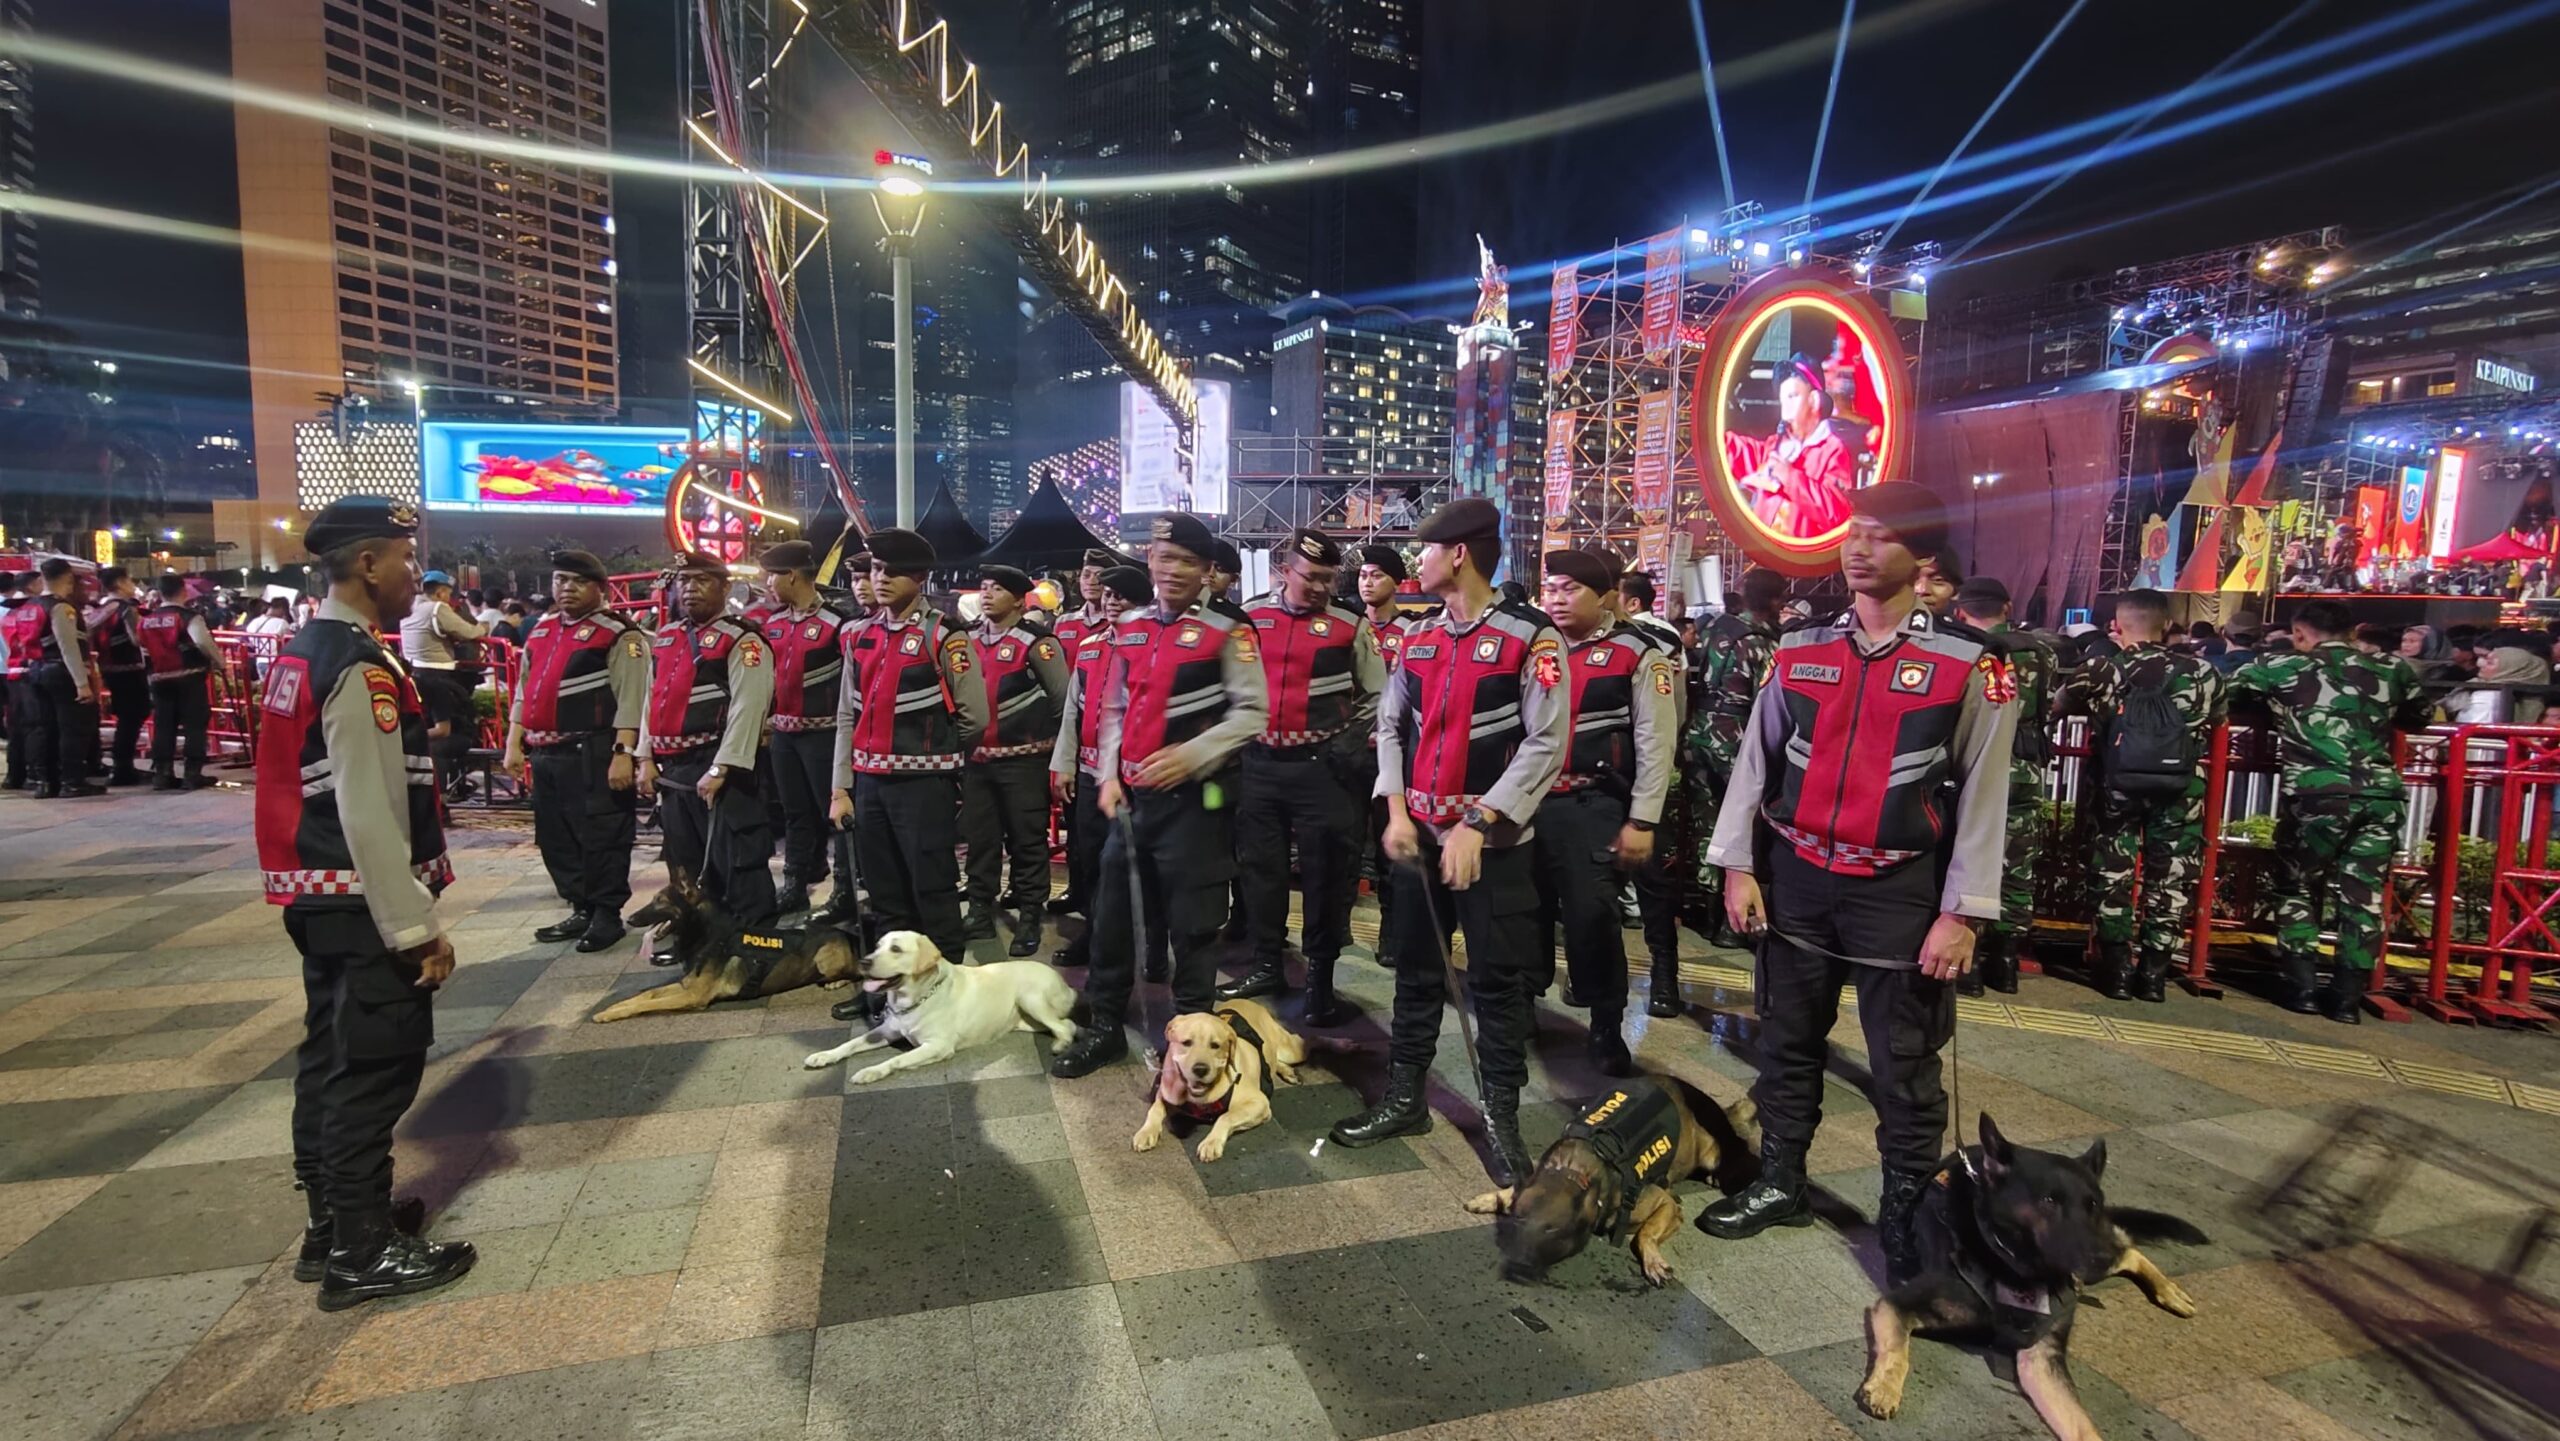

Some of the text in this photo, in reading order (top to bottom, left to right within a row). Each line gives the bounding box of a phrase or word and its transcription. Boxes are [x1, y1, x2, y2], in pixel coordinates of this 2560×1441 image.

[1273, 327, 1313, 352] KEMPINSKI
[2476, 358, 2535, 392] KEMPINSKI
[143, 616, 176, 629] POLISI
[1791, 665, 1839, 680] ANGGA K
[743, 934, 783, 949] POLISI
[1585, 1092, 1628, 1125] POLISI
[1634, 1136, 1671, 1179] POLISI
